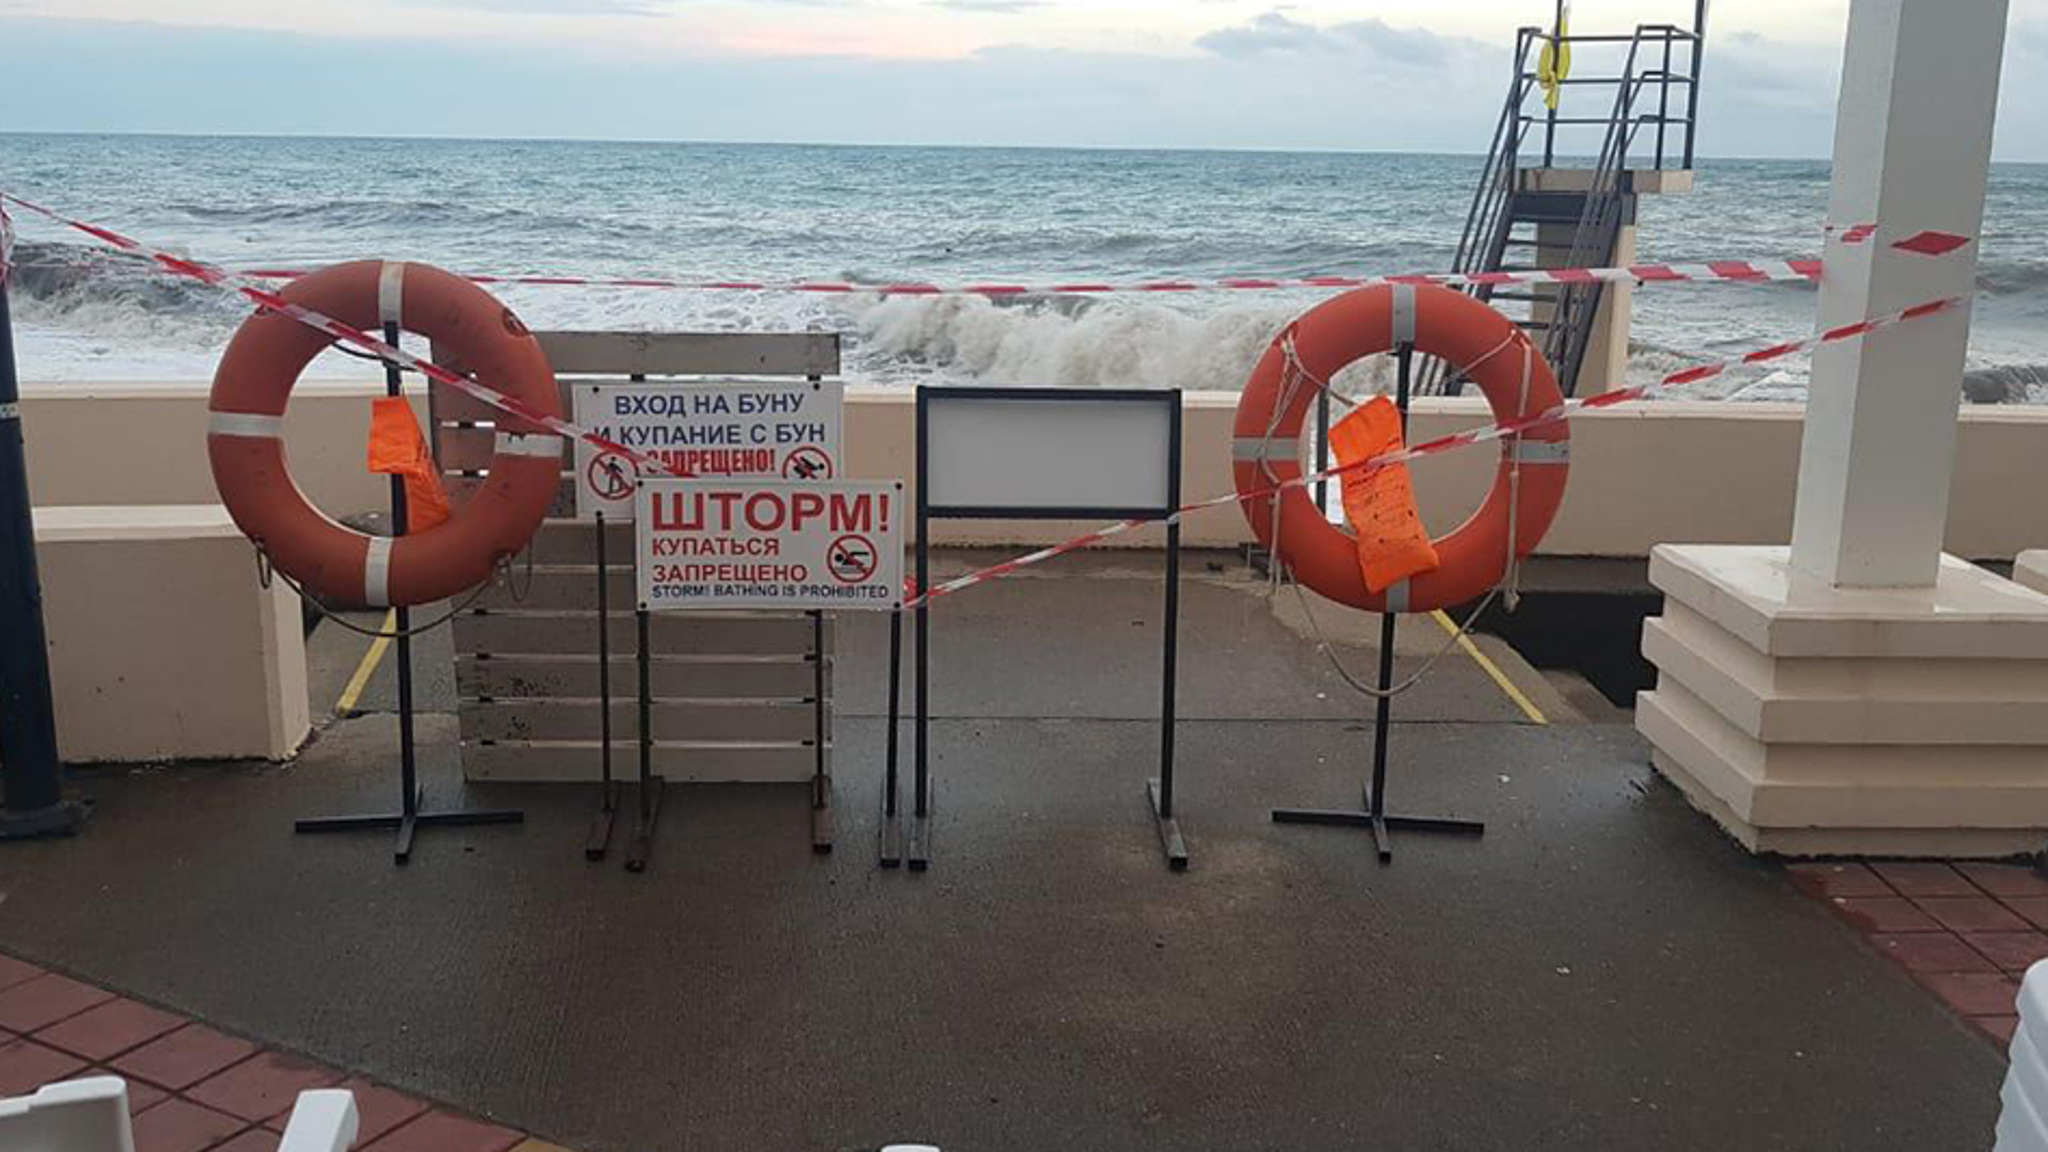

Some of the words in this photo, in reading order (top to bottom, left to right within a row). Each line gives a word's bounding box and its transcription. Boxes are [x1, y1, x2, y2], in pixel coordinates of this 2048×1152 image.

[615, 394, 686, 418] ВХОД
[694, 395, 730, 414] НА
[738, 393, 804, 414] БУНУ
[620, 424, 742, 445] КУПАНИЕ
[750, 424, 767, 444] С
[776, 423, 825, 443] БУН
[651, 493, 889, 532] ШТОРМ!
[652, 538, 779, 556] КУПАТЬСЯ
[652, 564, 808, 584] ЗАПРЕЩЕНО
[652, 585, 710, 598] STORM!
[713, 585, 779, 597] BATHING
[782, 585, 796, 597] IS
[801, 585, 889, 598] PROHIBITED
